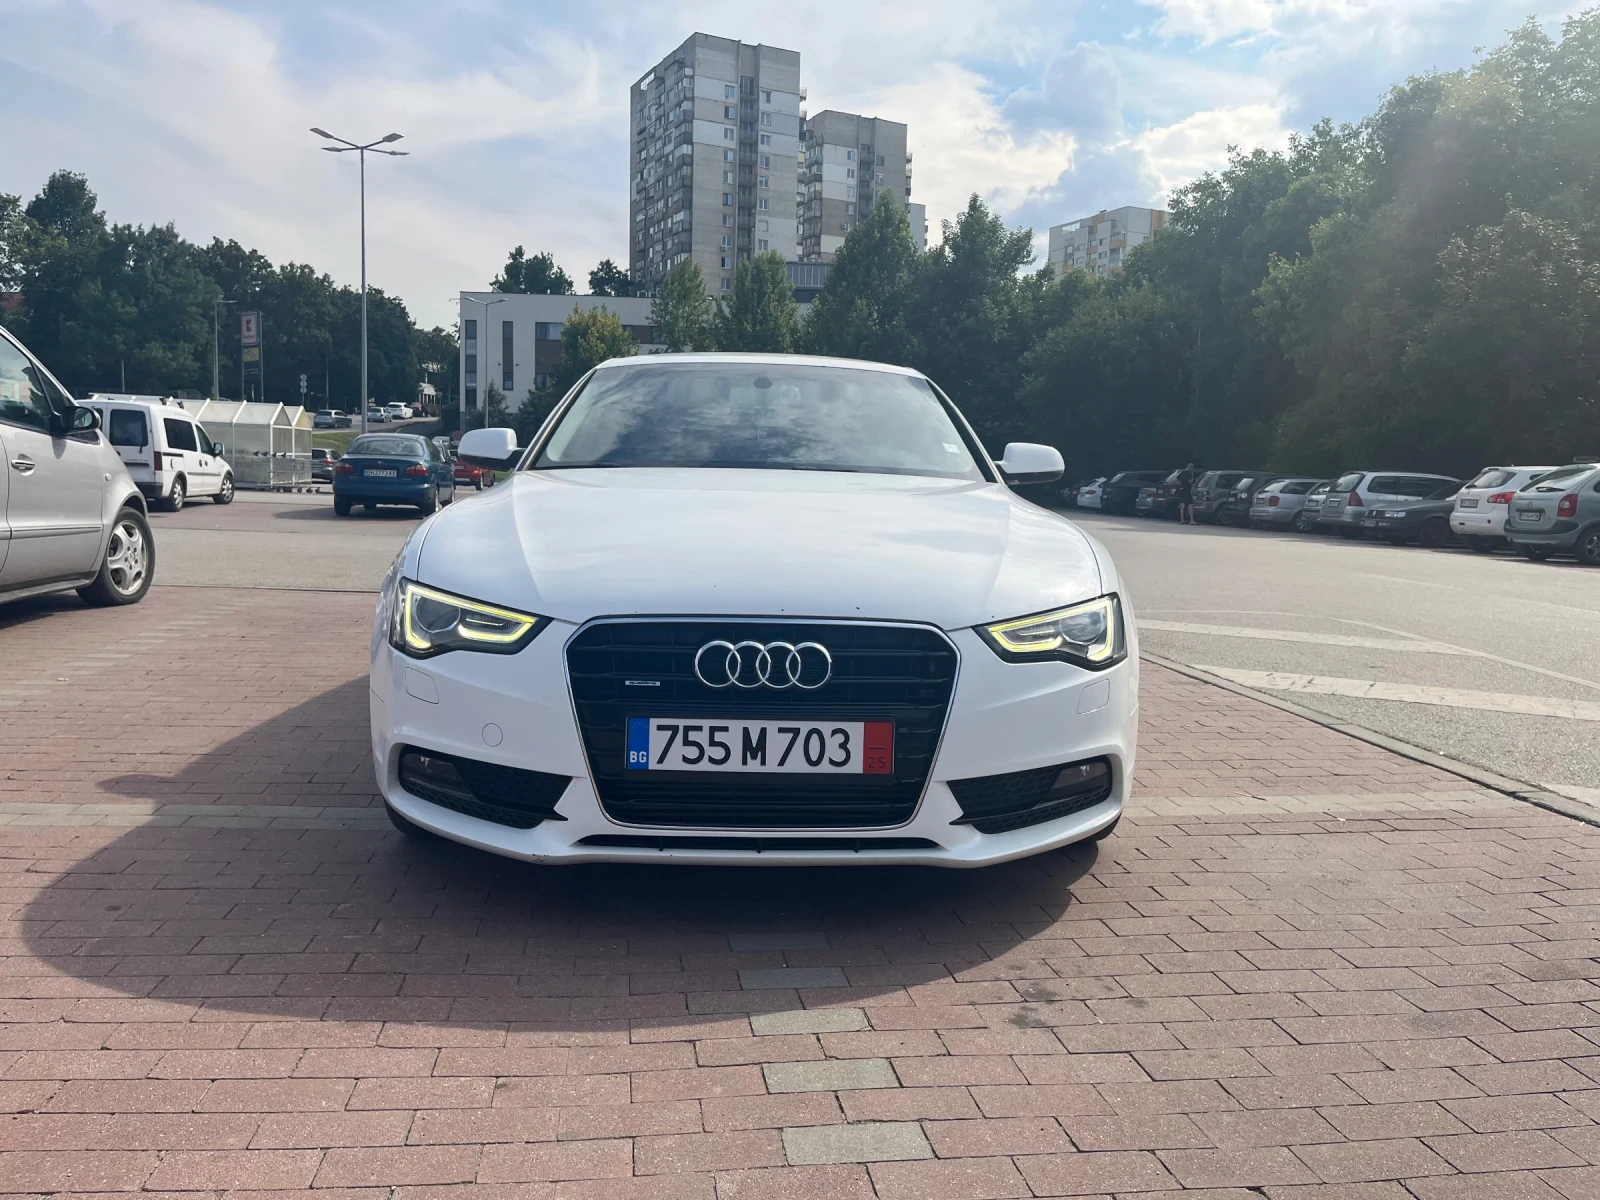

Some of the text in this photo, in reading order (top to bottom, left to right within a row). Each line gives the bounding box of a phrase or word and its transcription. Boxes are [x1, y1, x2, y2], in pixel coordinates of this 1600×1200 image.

[656, 725, 851, 768] 755 M 703
[630, 751, 647, 763] BG
[868, 756, 886, 769] 25
